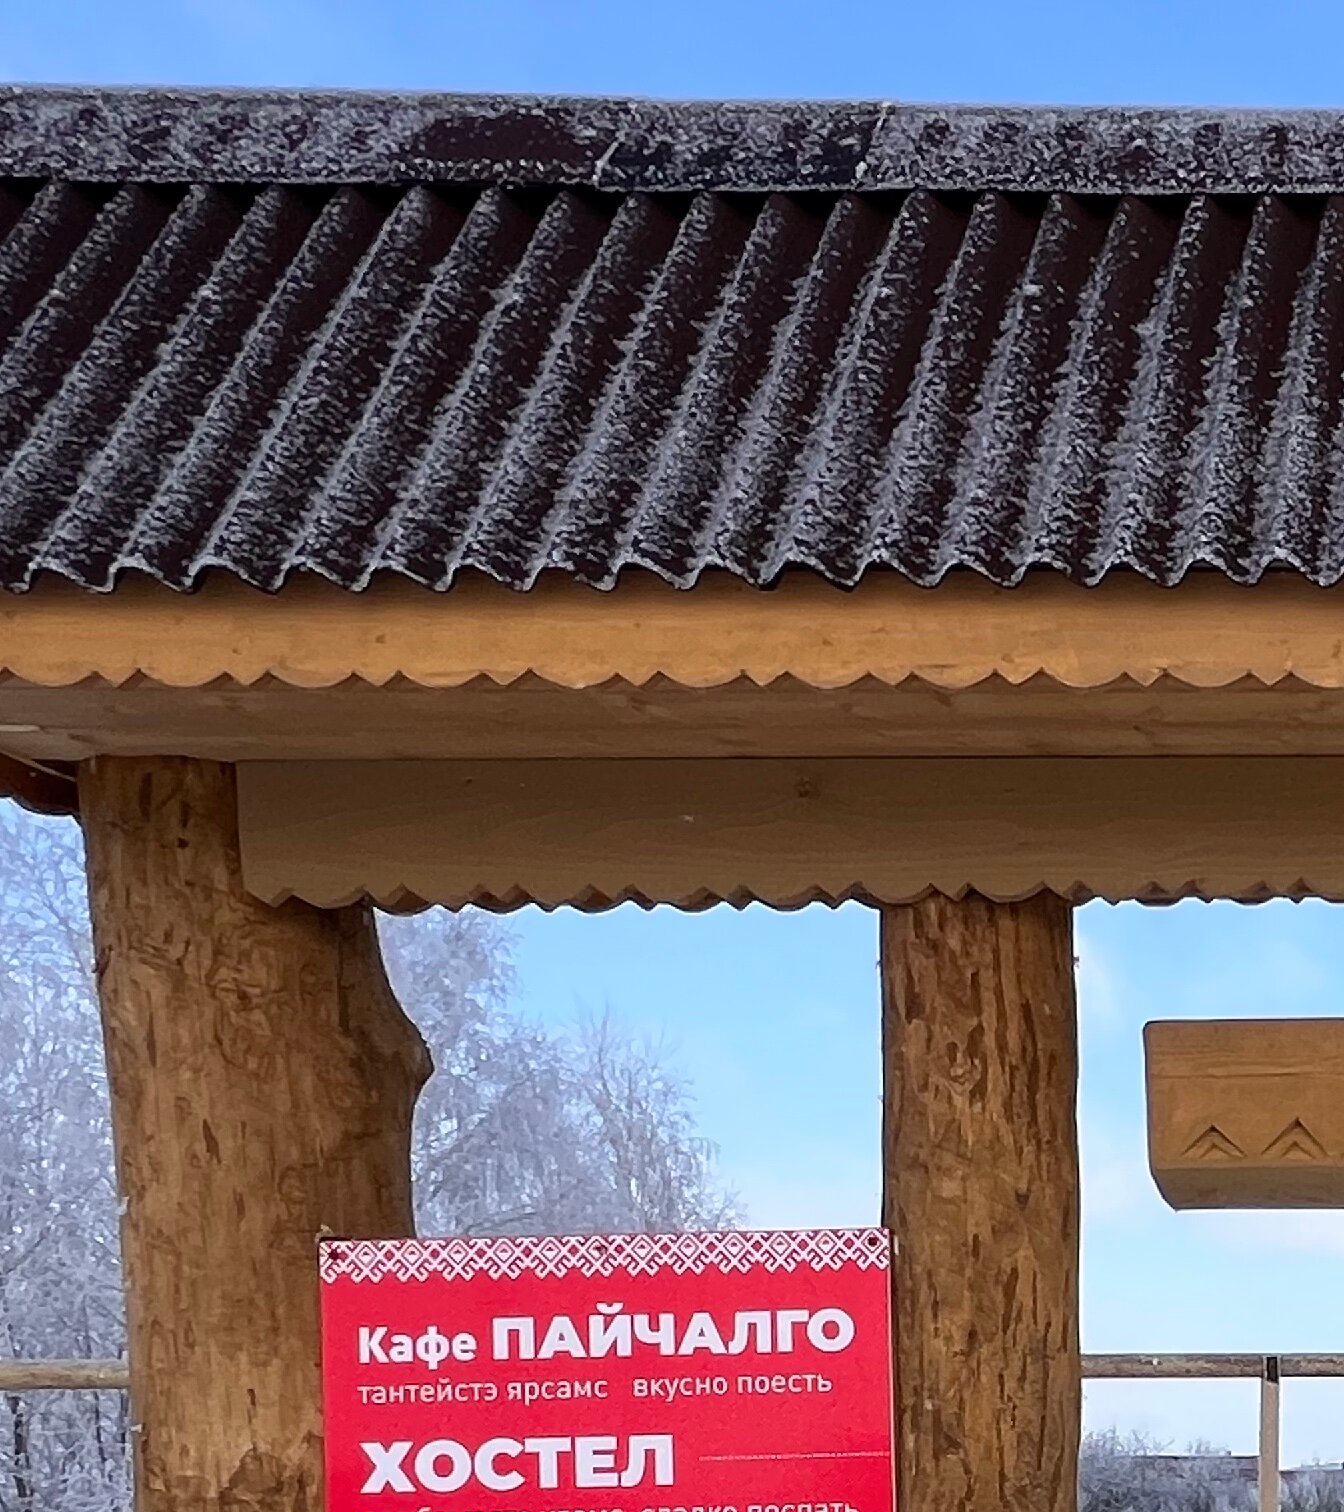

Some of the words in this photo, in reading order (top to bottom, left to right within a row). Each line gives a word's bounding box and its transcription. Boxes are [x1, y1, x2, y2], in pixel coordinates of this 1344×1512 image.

[359, 1326, 477, 1369] Кафе
[493, 1303, 854, 1359] ПАЙЧАЛГО
[357, 1378, 497, 1403] тантейстэ
[507, 1381, 607, 1406] ярсамс
[634, 1377, 727, 1401] вкусно
[738, 1374, 831, 1393] поесть
[360, 1435, 673, 1493] ХОСТЕЛ
